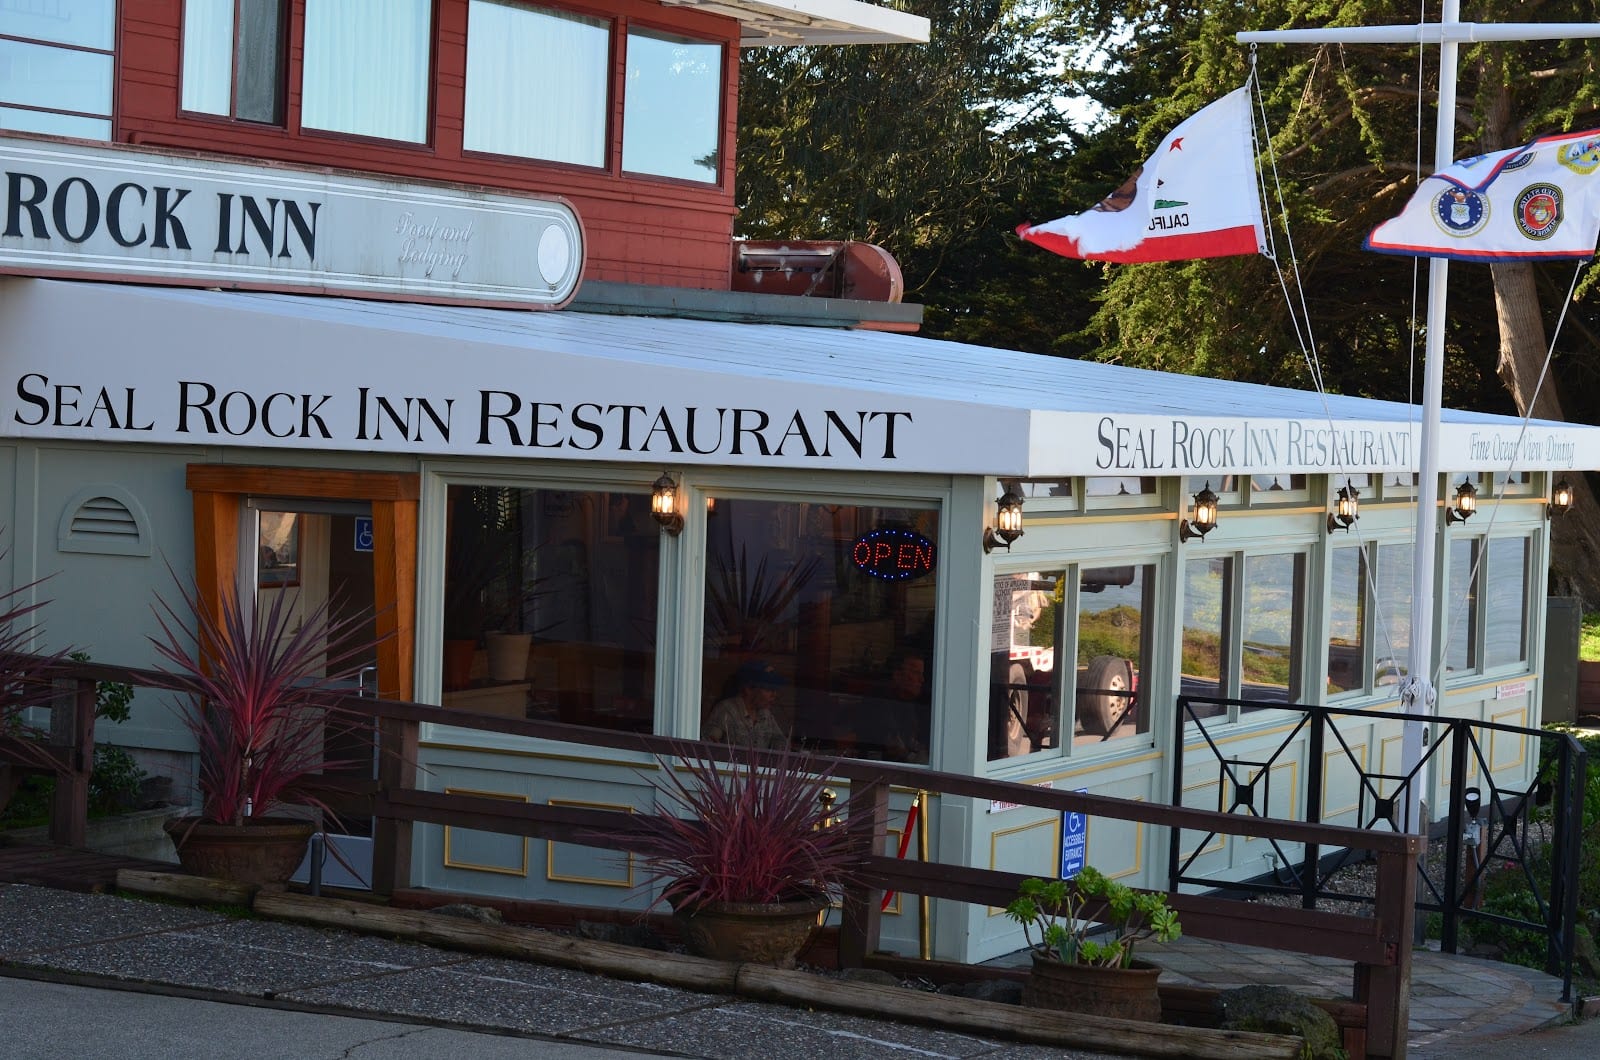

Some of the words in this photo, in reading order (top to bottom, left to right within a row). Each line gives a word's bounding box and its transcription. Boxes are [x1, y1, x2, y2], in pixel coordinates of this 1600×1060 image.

[2, 171, 192, 250] ROCK
[214, 192, 322, 263] INN
[395, 212, 439, 240] Food
[440, 220, 473, 241] and
[14, 373, 154, 431] SEAL
[175, 381, 333, 439] ROCK
[355, 387, 455, 444] INN
[476, 389, 913, 460] RESTAURANT
[1096, 416, 1164, 469] SEAL
[1171, 420, 1236, 469] ROCK
[1243, 421, 1279, 467] INN
[1286, 420, 1410, 467] RESTAURANT
[1470, 431, 1490, 461] Fine
[1493, 433, 1519, 461] Ocean
[1523, 431, 1545, 461] View
[1546, 434, 1575, 469] Dining
[853, 541, 933, 570] OPEN
